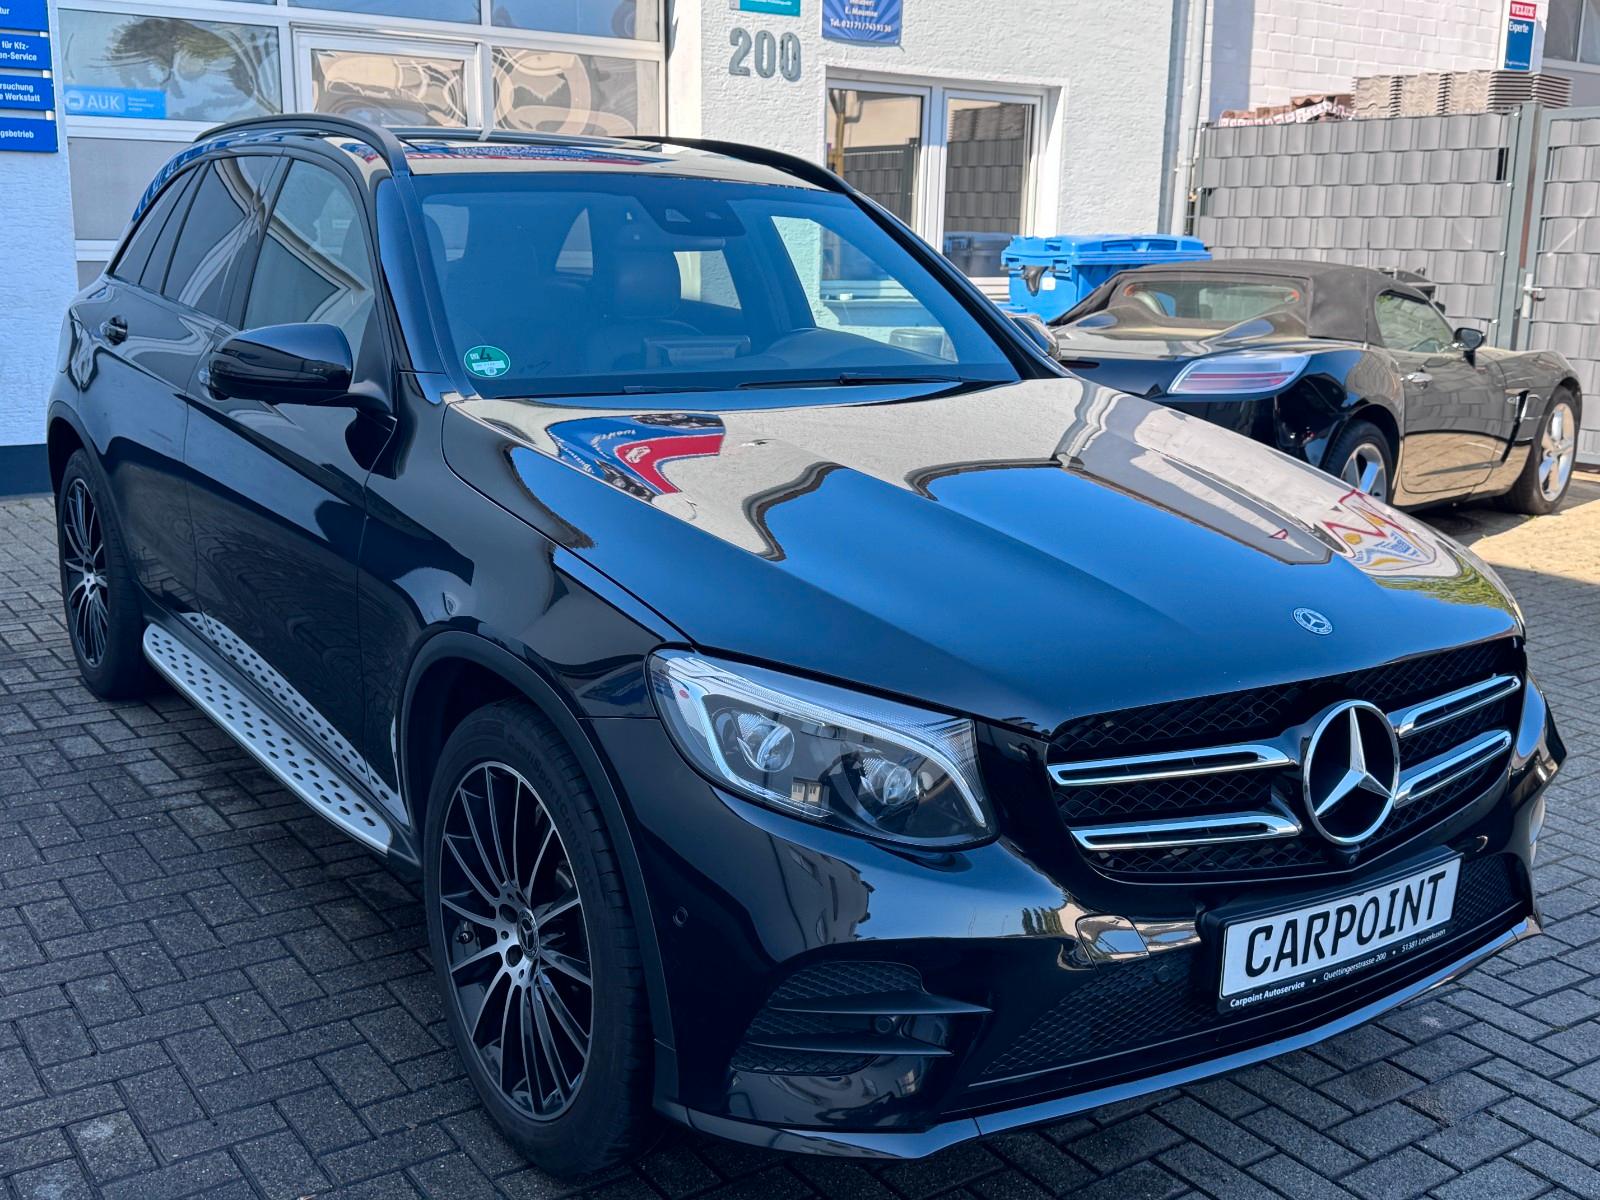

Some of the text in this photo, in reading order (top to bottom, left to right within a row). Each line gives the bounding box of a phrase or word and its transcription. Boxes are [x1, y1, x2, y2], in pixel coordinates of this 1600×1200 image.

[1509, 21, 1529, 34] Experte
[1, 40, 30, 50] für Kfz-
[729, 27, 801, 82] 200
[5, 92, 40, 102] Werkstatt
[87, 95, 120, 110] AUK
[1245, 870, 1447, 978] CARPOINT
[1418, 928, 1446, 946] Leverkusen
[1323, 952, 1387, 981] Quettingerstrasse 200
[1230, 981, 1305, 1007] Carpoint Autoservice
